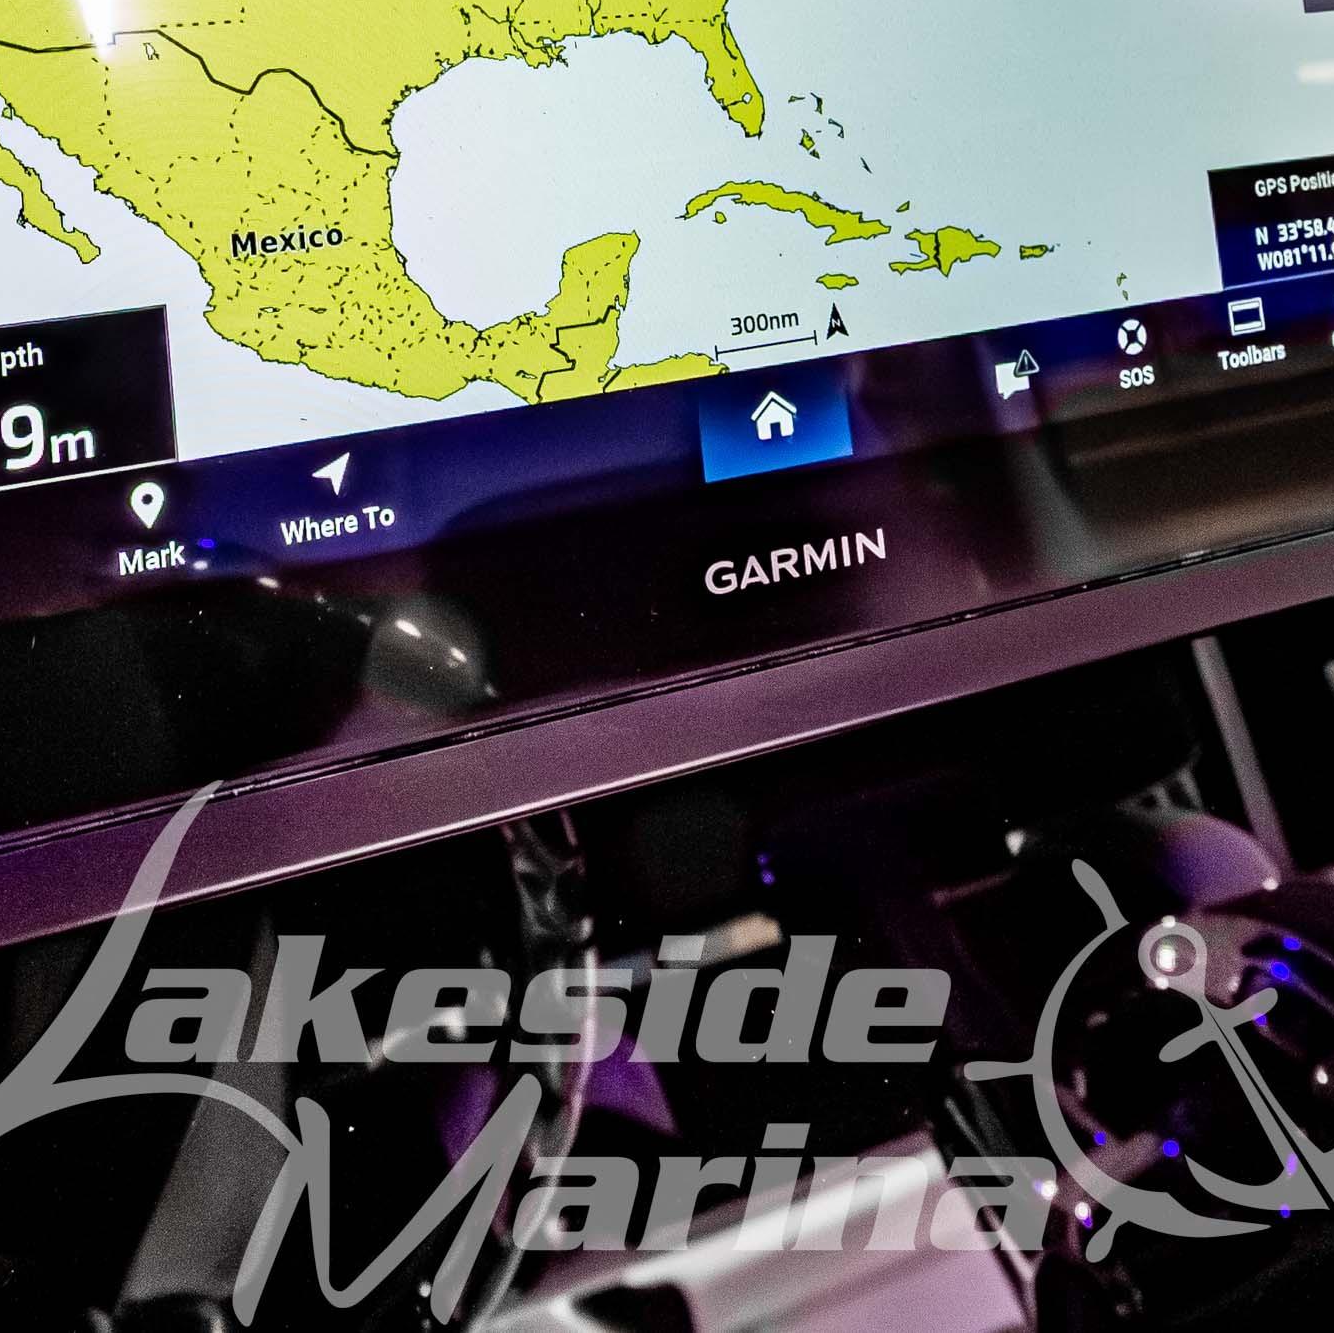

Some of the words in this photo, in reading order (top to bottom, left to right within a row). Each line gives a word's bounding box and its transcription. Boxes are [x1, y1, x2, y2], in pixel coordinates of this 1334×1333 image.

[1254, 175, 1288, 198] GPS
[230, 224, 344, 258] Mexico
[1255, 225, 1269, 246] N
[730, 312, 800, 336] 300nm
[1217, 343, 1287, 372] Toolbars
[1119, 365, 1156, 389] SOS
[280, 514, 360, 546] Where
[362, 505, 396, 532] To
[118, 540, 187, 576] Mark
[704, 528, 887, 595] GARMIN
